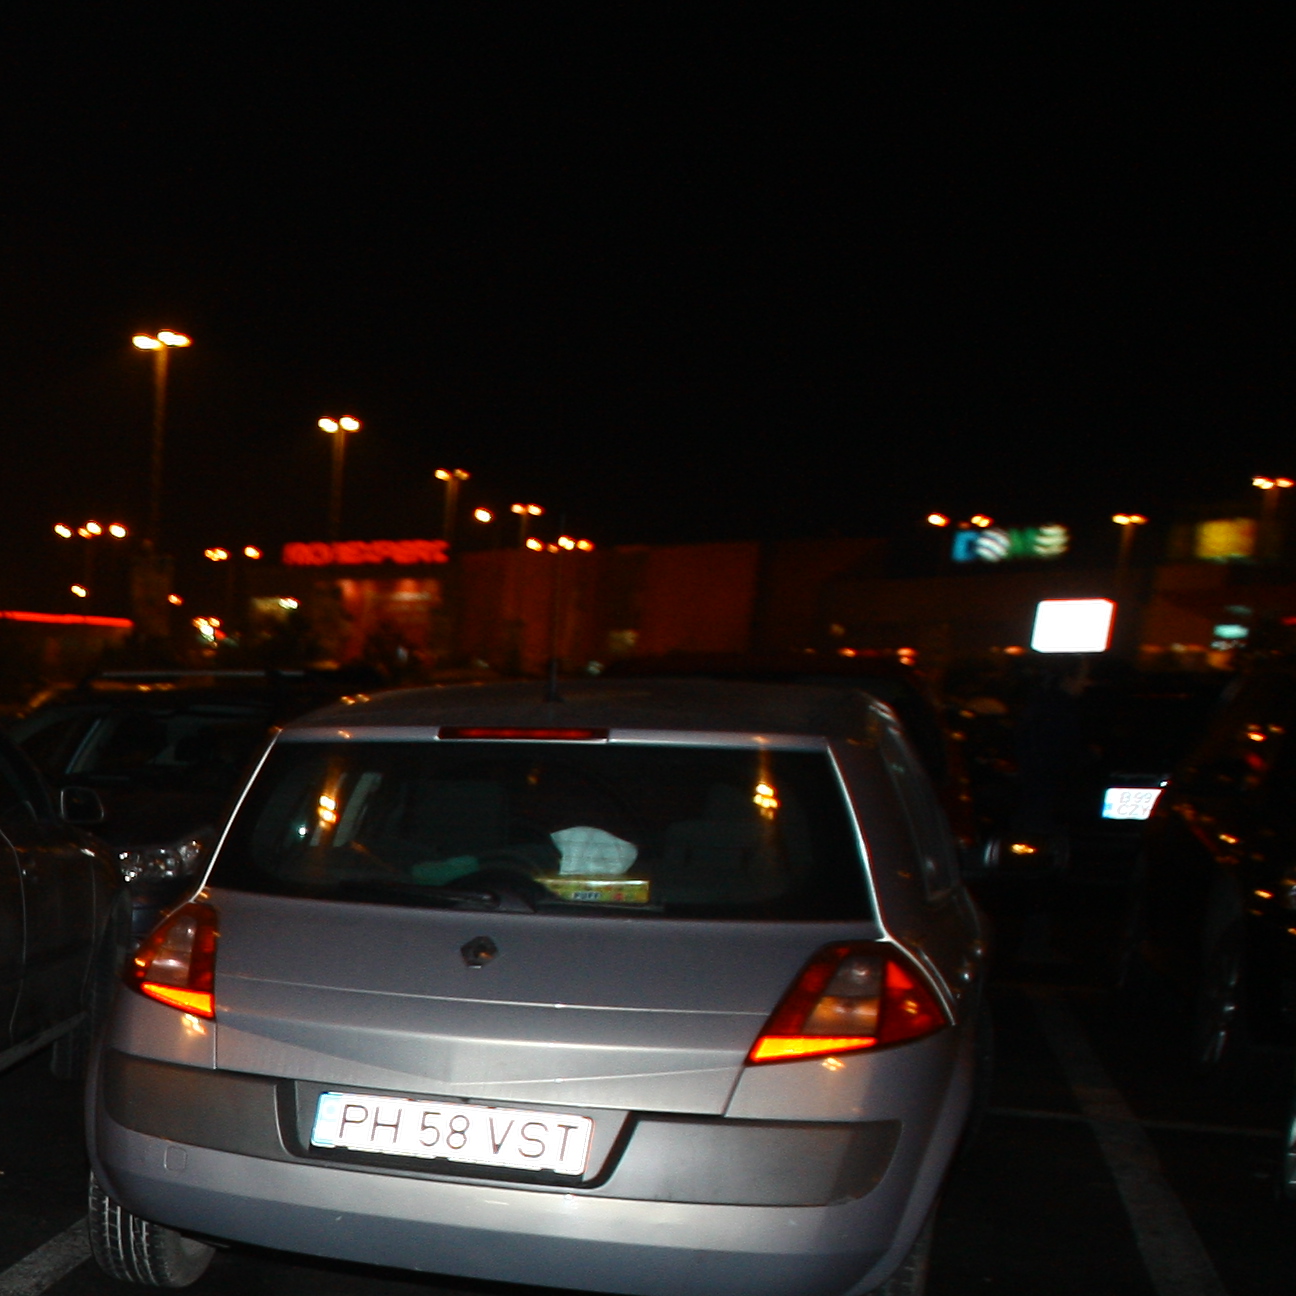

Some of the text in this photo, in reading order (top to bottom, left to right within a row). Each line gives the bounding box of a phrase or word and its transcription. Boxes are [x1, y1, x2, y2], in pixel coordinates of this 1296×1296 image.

[338, 1103, 579, 1162] PH 58 VST
